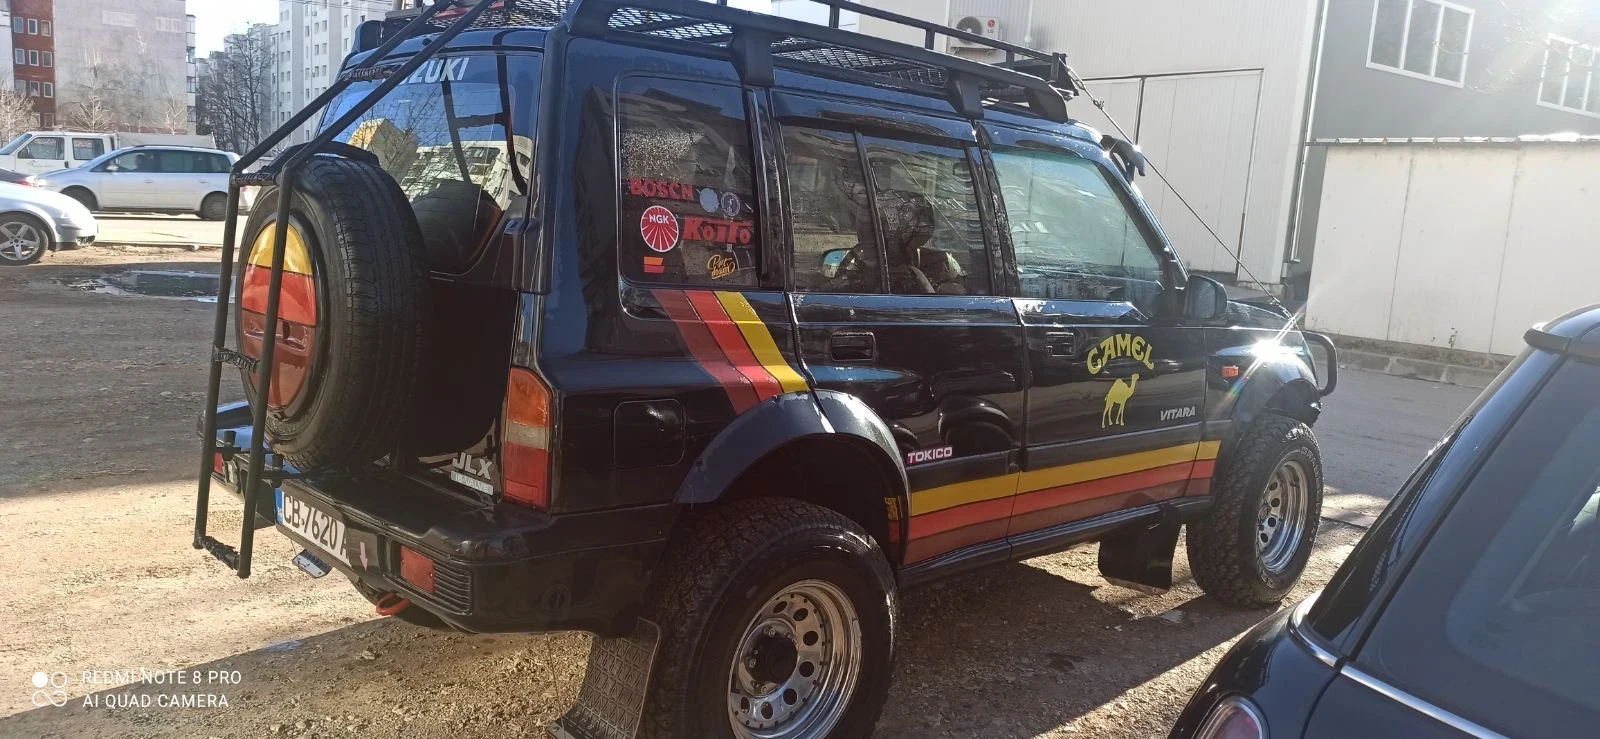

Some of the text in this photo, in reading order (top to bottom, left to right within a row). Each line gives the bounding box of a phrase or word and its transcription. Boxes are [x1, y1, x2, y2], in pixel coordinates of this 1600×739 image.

[381, 57, 470, 86] ZUKI
[629, 179, 694, 201] BOSCH
[649, 214, 669, 224] NGK
[1087, 333, 1155, 374] CAMEL
[1160, 406, 1196, 421] VITARA
[452, 451, 492, 480] JLX
[907, 446, 953, 464] TOKICO
